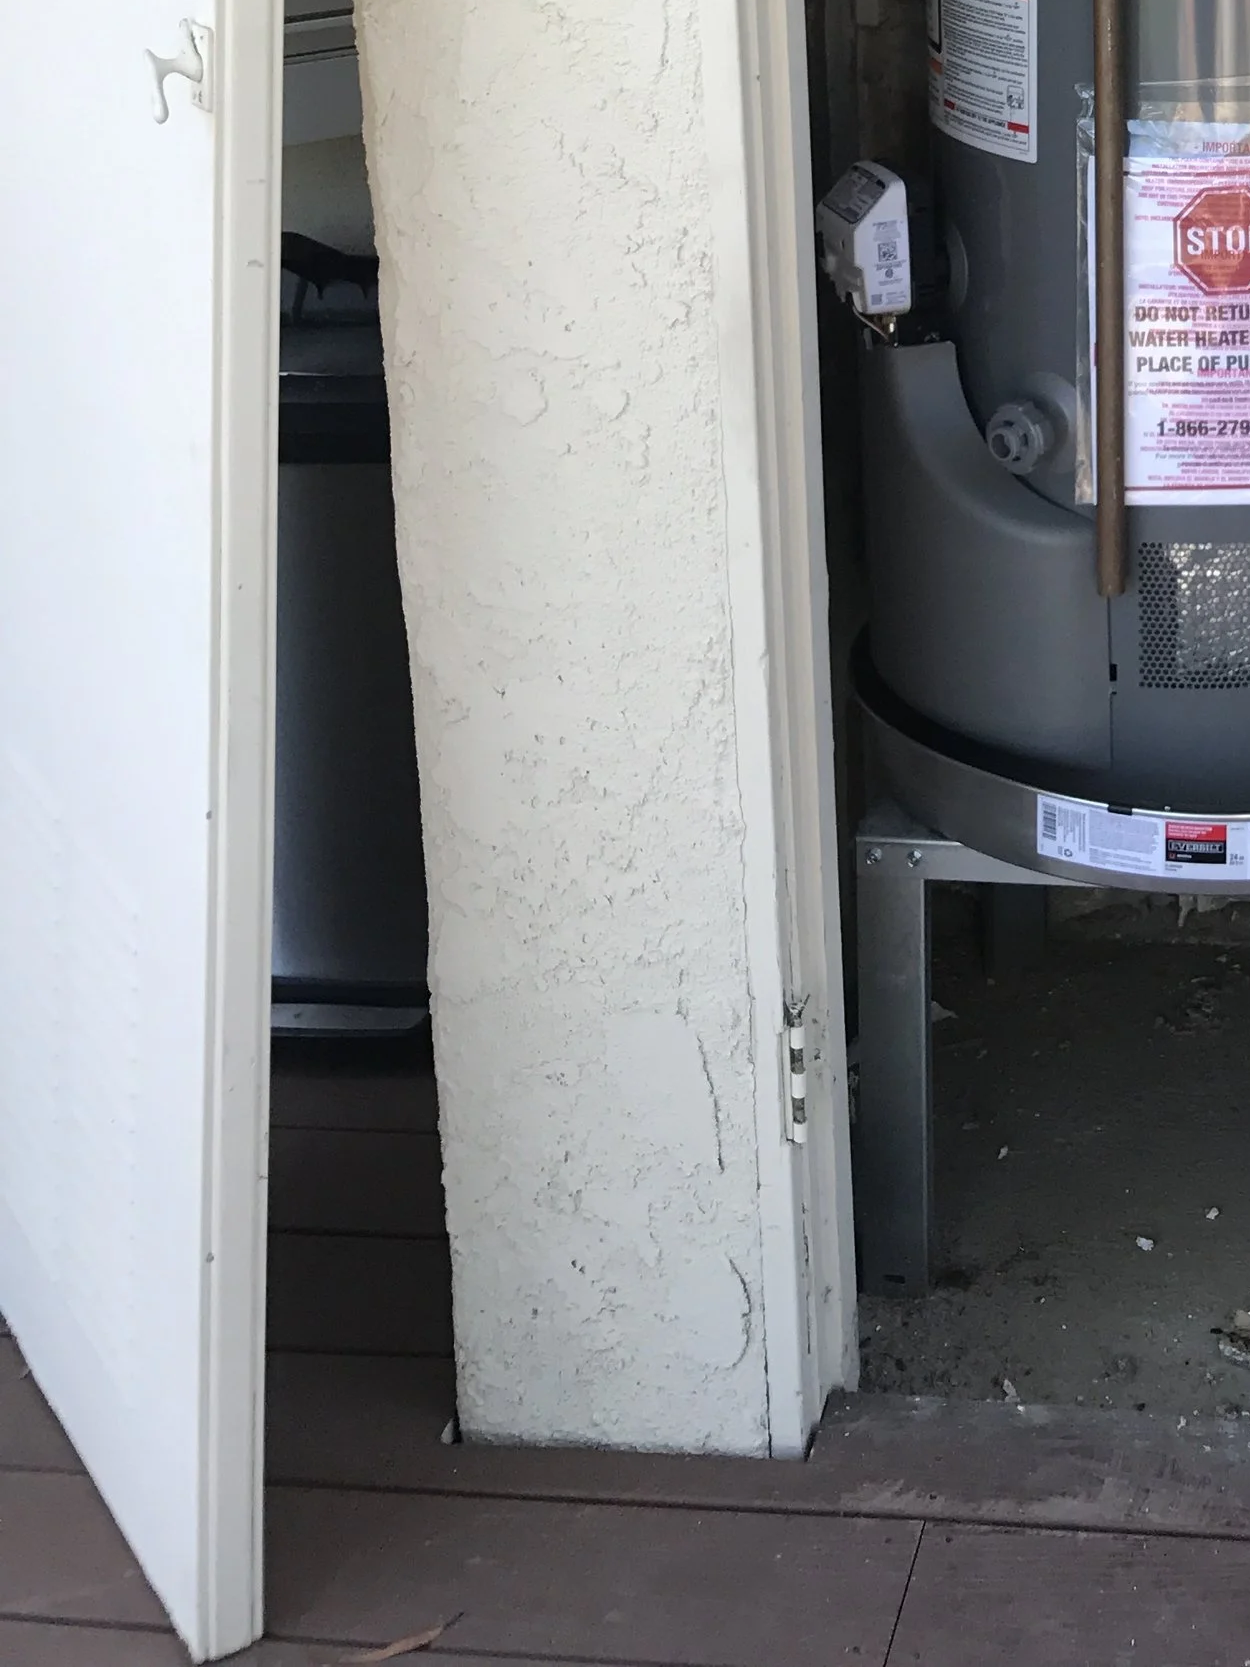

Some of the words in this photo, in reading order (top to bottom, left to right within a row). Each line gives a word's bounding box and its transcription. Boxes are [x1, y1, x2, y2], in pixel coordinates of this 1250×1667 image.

[1134, 305, 1159, 322] DO
[1163, 305, 1200, 322] NOT
[1128, 330, 1189, 348] WATER
[1136, 356, 1193, 373] PLACE
[1199, 355, 1221, 372] OF
